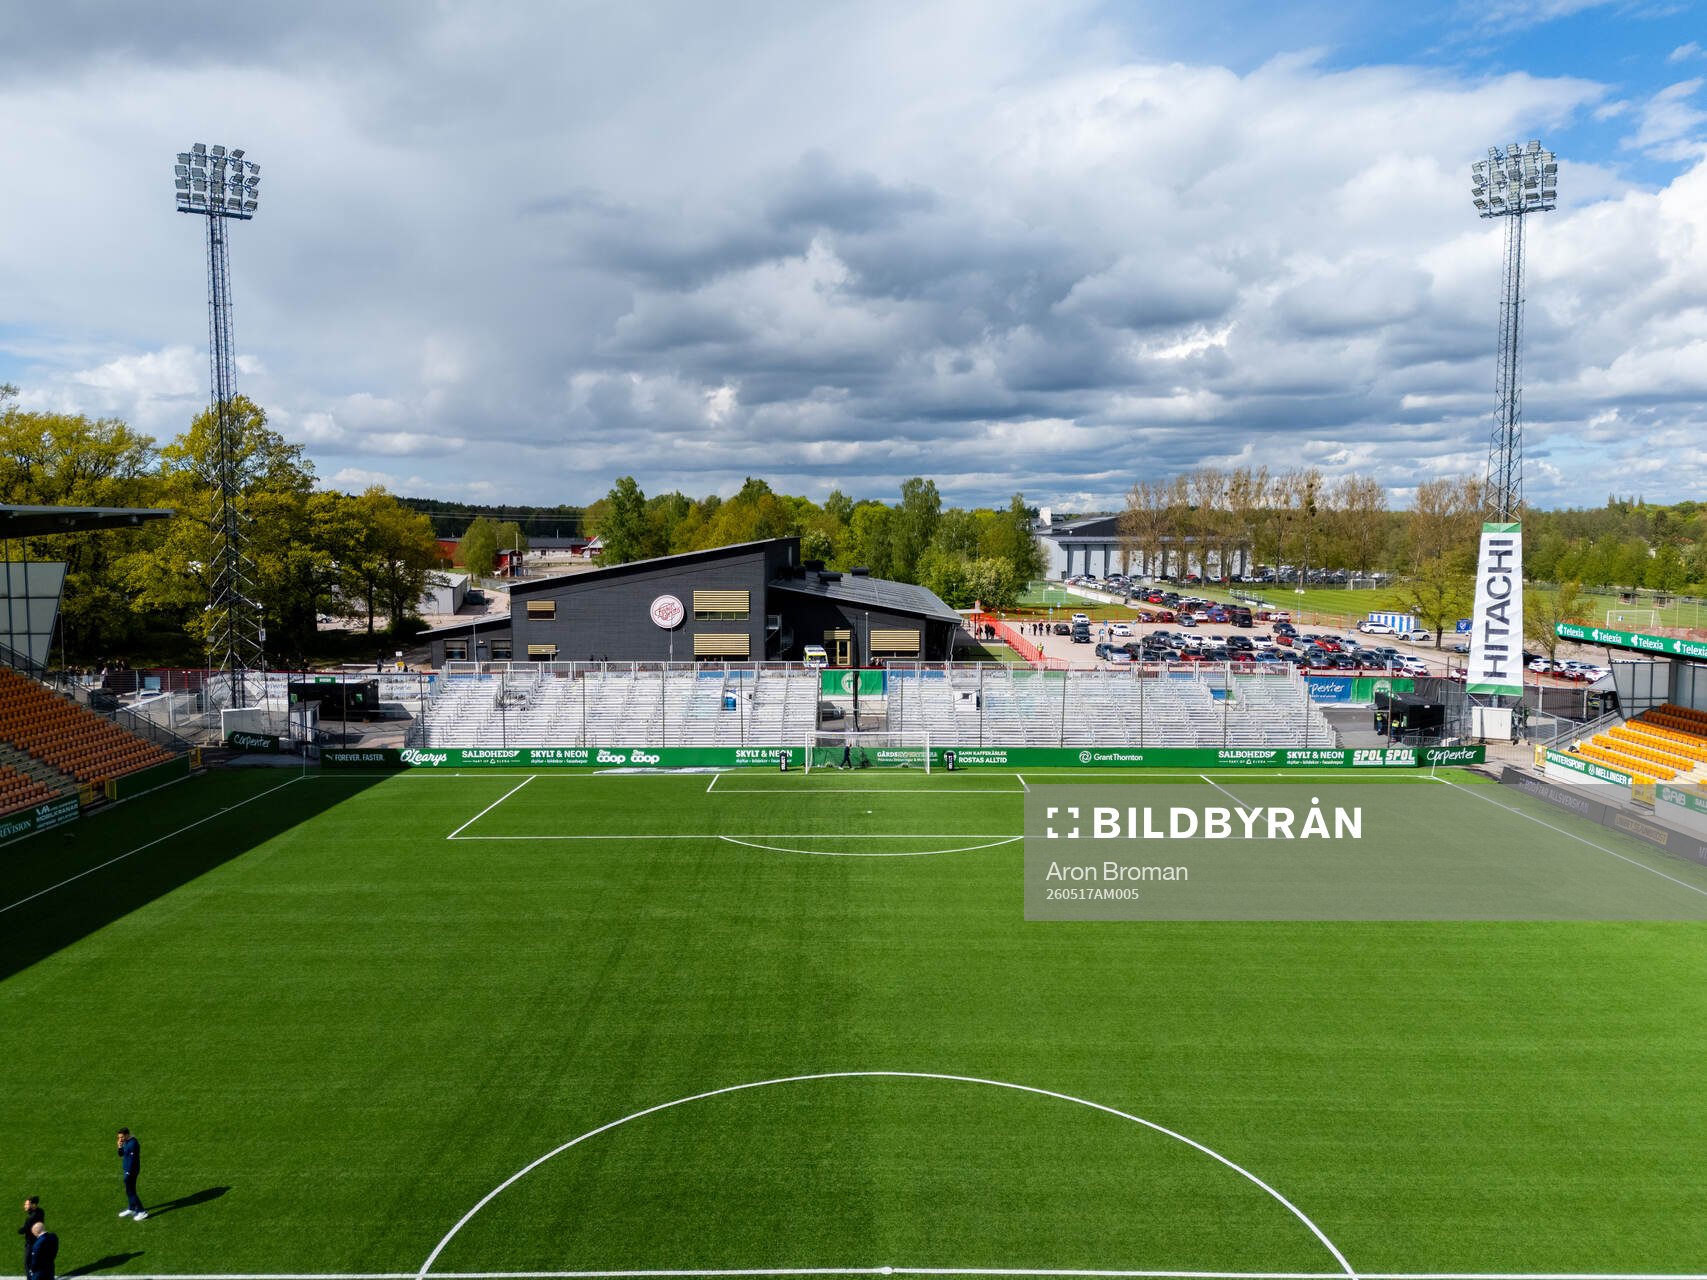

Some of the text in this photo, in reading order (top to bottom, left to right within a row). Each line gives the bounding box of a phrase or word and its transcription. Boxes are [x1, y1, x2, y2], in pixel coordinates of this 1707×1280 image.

[1483, 540, 1513, 678] HITACHI
[1563, 626, 1584, 638] Telexia
[1600, 632, 1622, 644] Telexia
[1639, 638, 1664, 650] Telexia
[462, 750, 514, 758] SALBOHEDS
[530, 750, 588, 758] SKYLT & NEON
[1286, 751, 1345, 759] SKYLT & NEON
[1353, 750, 1383, 761] SPOL
[1385, 750, 1415, 761] SPOL
[1426, 747, 1477, 765] Carpenter
[1595, 768, 1627, 785] MELLINGER
